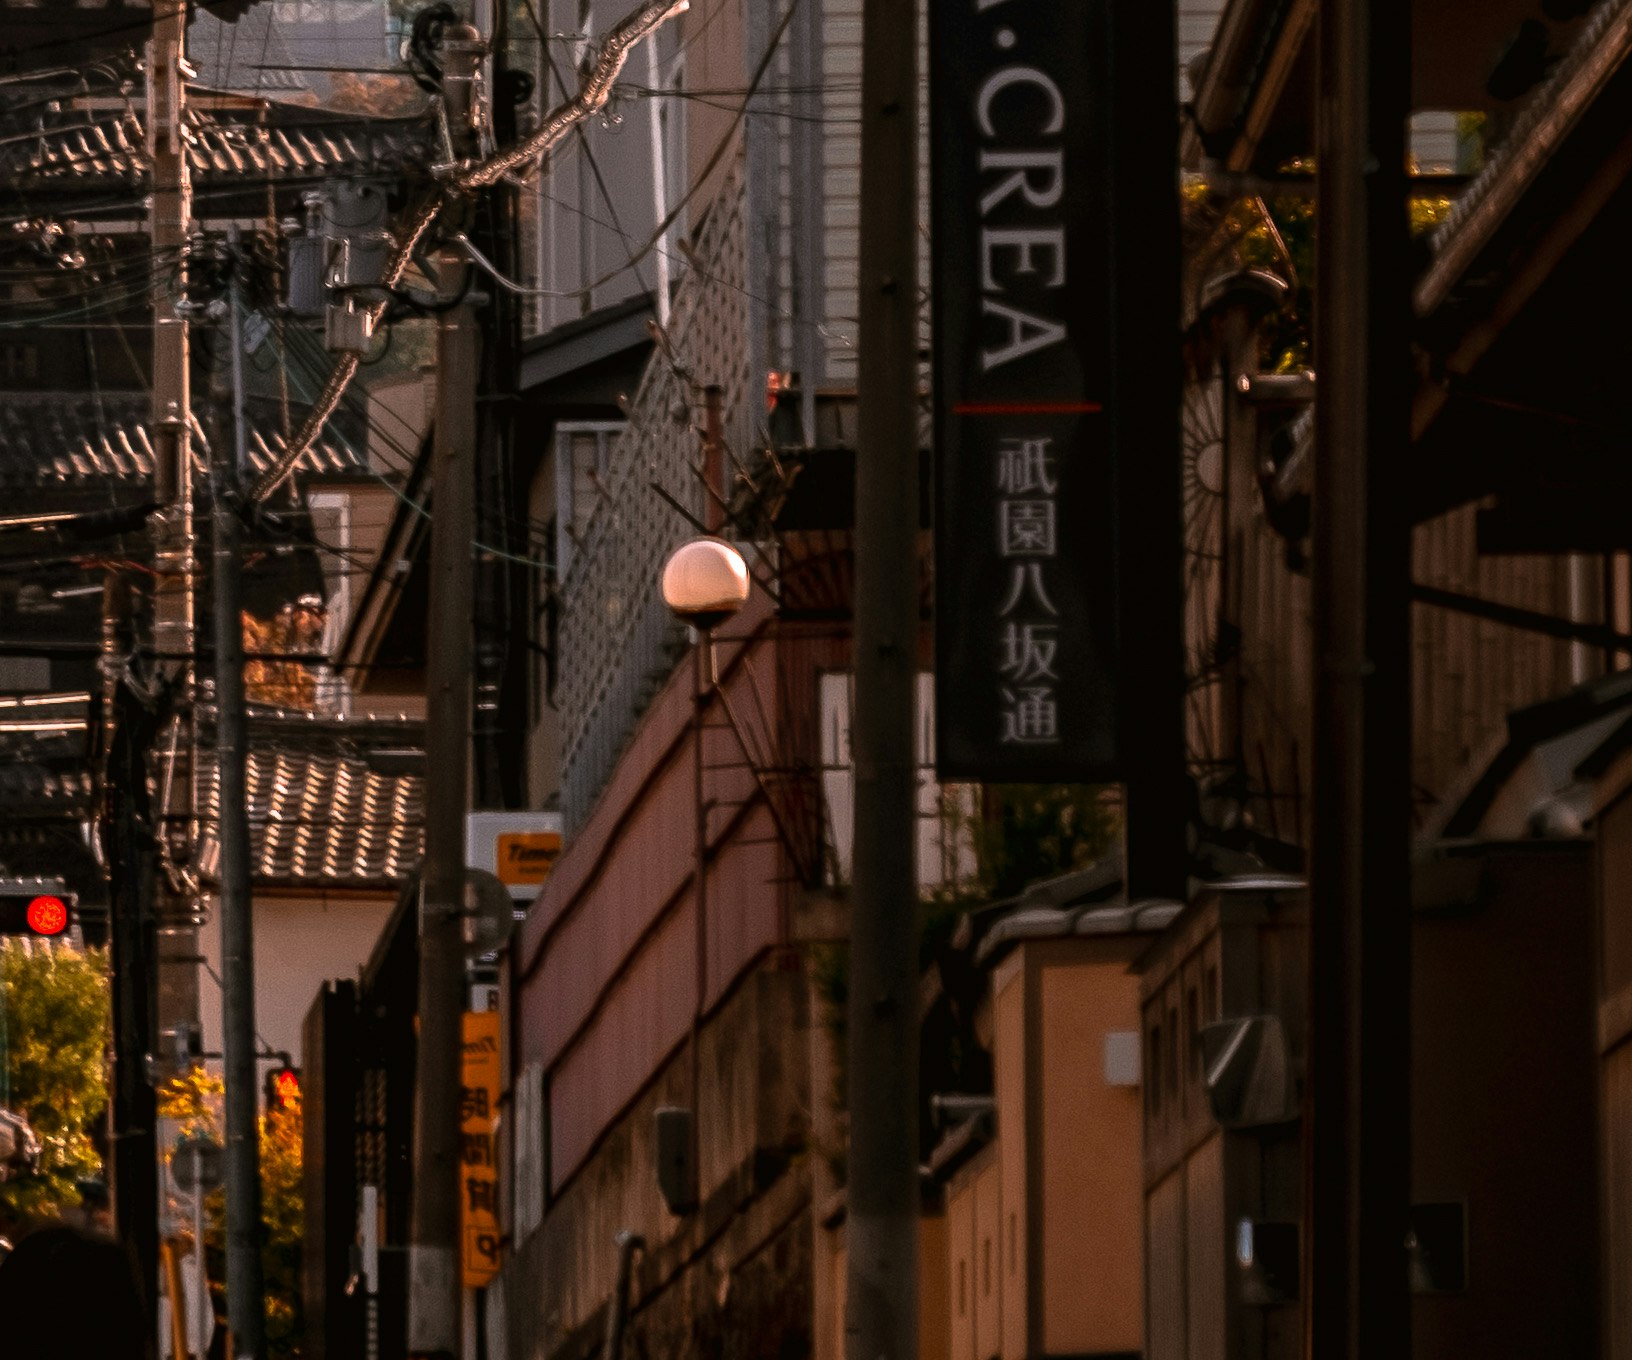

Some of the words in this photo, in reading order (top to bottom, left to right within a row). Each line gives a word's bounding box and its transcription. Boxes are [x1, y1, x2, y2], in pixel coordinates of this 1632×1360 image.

[996, 438, 1061, 745] 祇園八坂通
